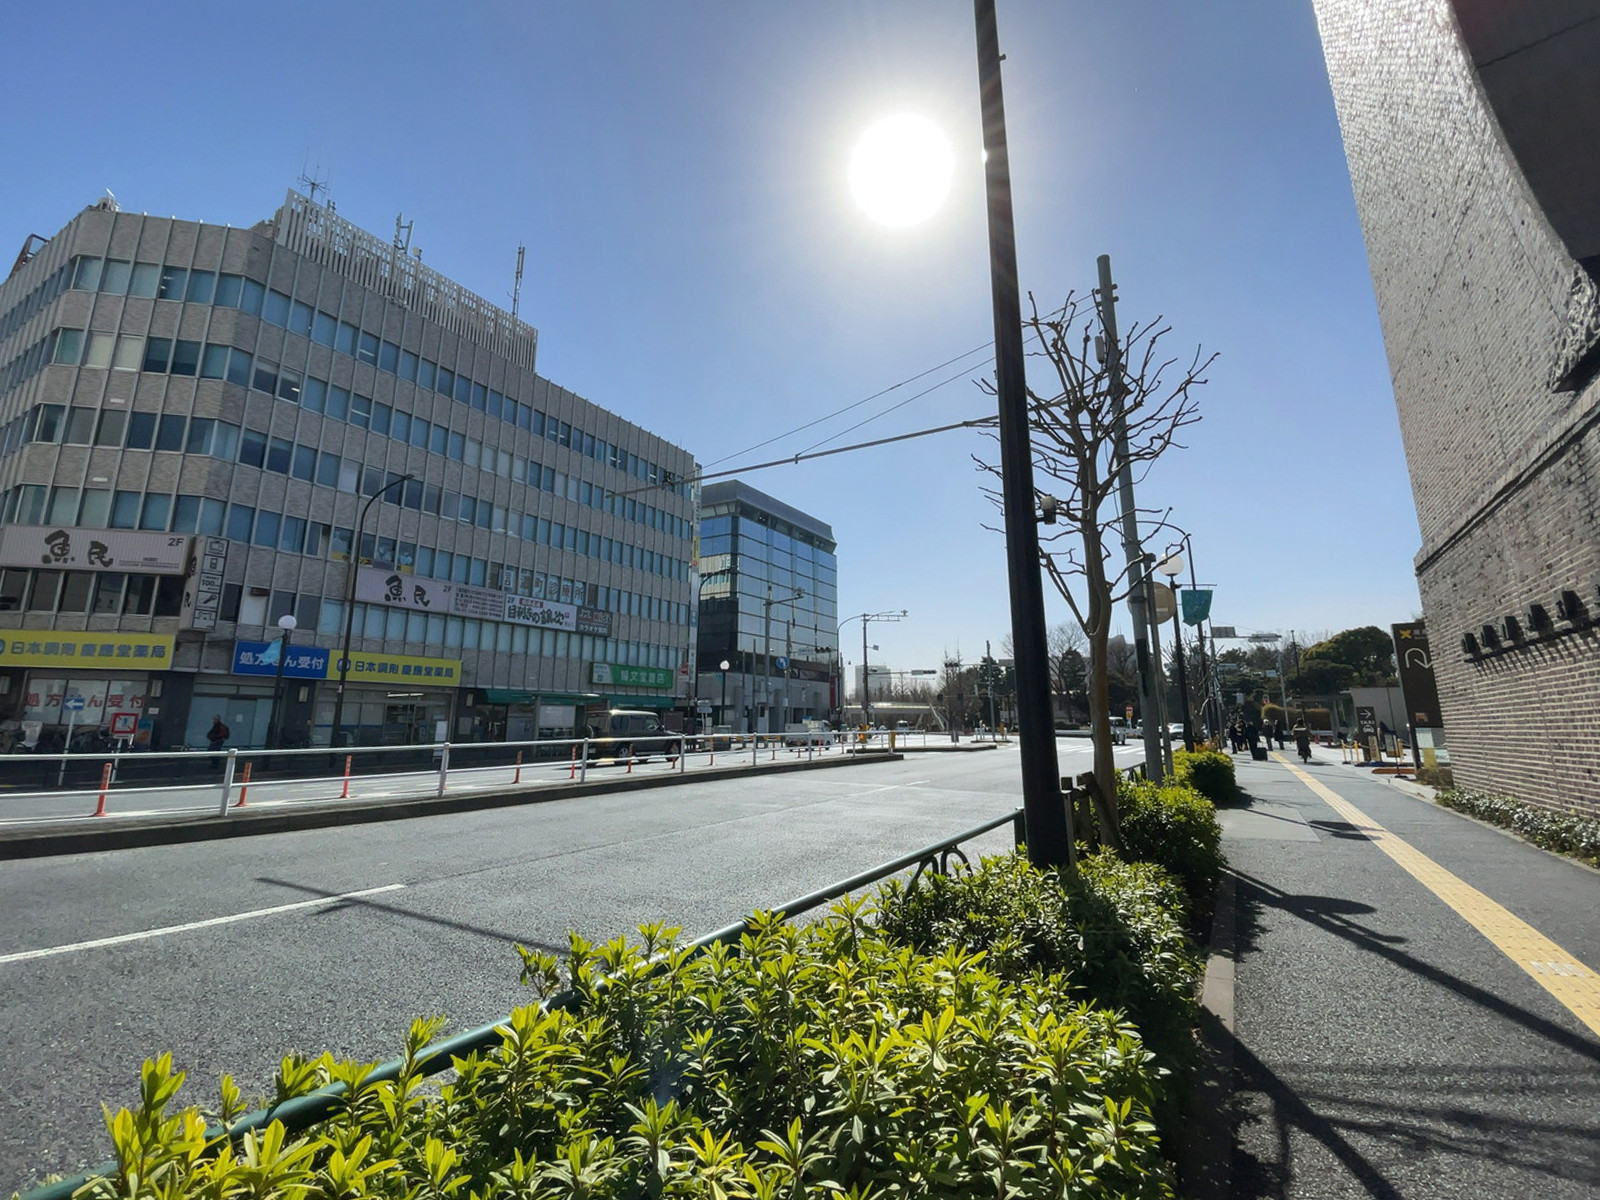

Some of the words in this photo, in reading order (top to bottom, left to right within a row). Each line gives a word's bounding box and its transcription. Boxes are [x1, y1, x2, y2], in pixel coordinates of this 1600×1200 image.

[41, 529, 113, 567] 魚民
[168, 537, 184, 547] 2F
[385, 574, 430, 606] 魚民
[443, 585, 453, 593] 2F
[25, 693, 146, 709] 処方ん受付
